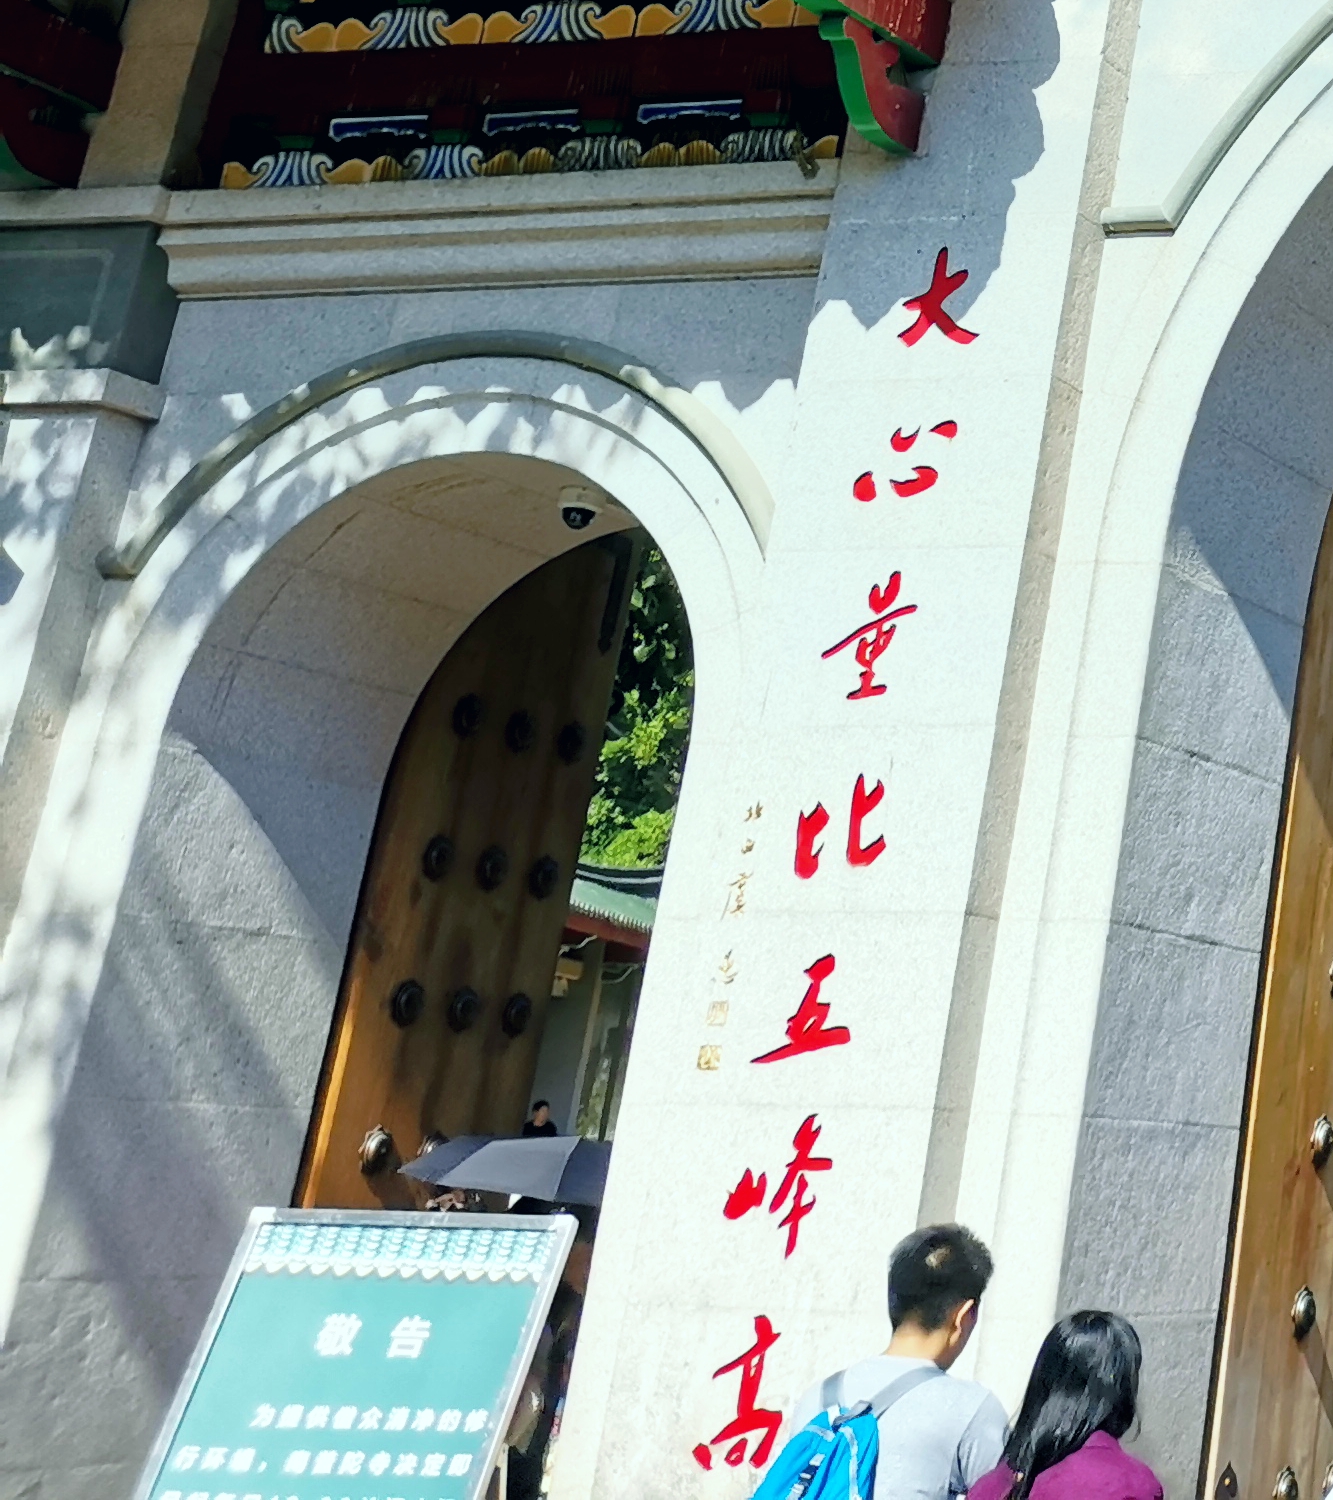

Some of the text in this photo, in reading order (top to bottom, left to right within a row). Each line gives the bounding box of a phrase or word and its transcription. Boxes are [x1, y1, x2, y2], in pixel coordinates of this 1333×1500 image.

[692, 246, 979, 1470] 大心量比五峰高
[314, 1312, 433, 1359] 敬告
